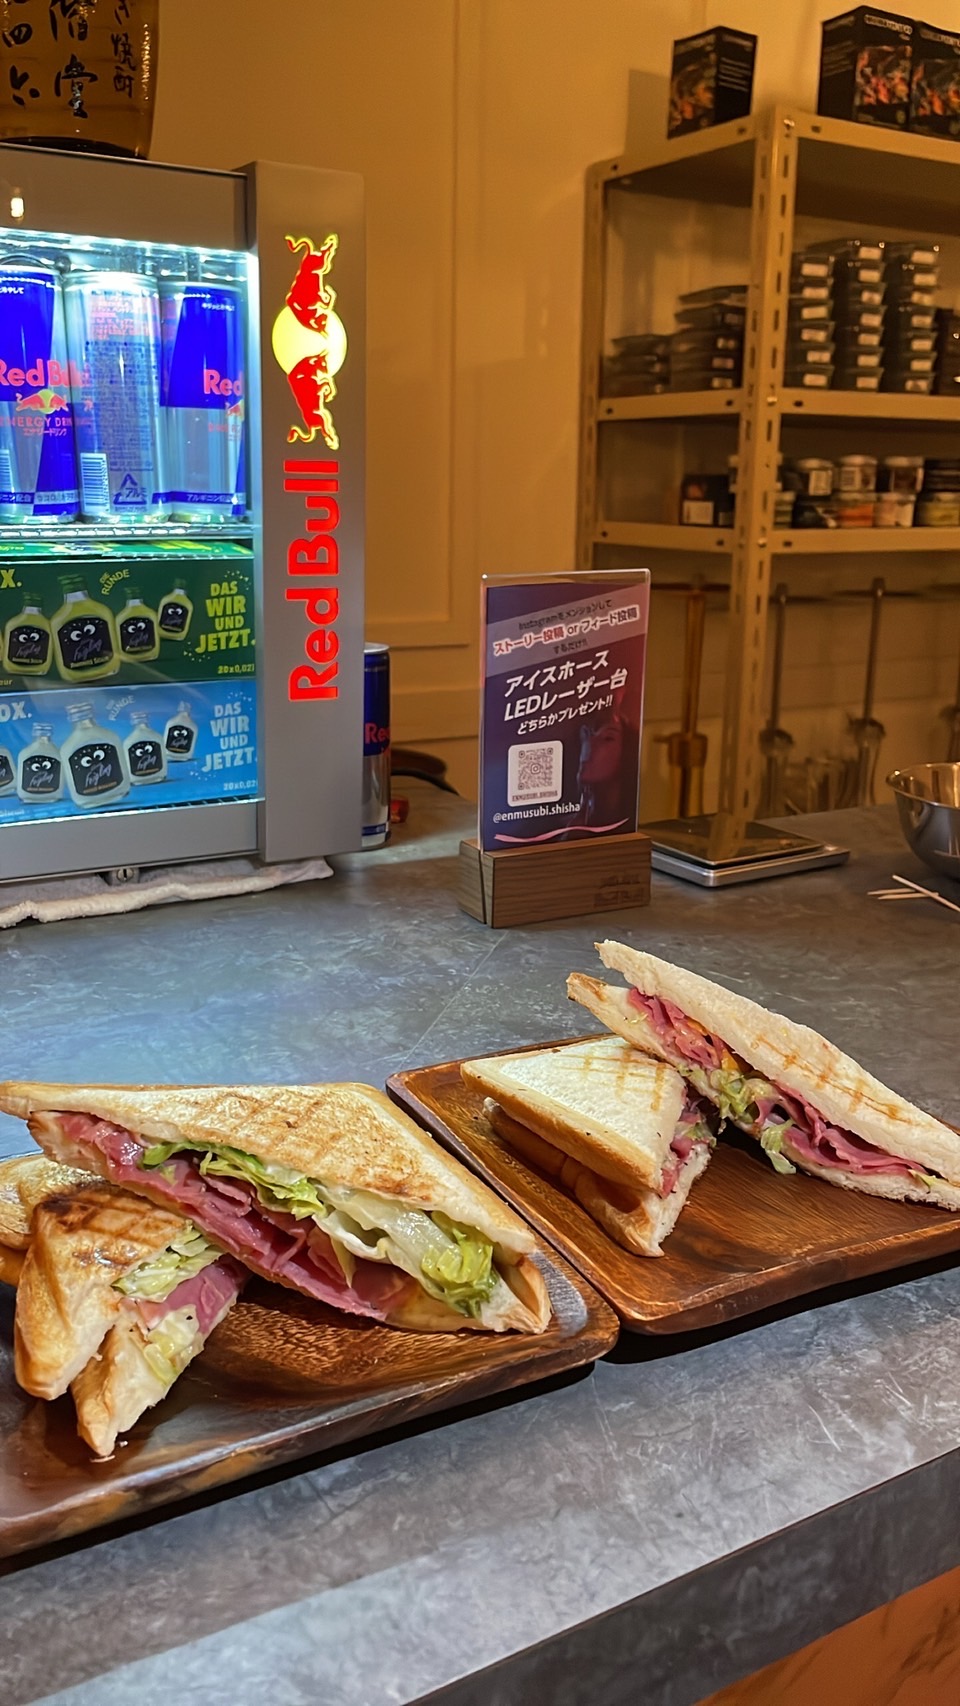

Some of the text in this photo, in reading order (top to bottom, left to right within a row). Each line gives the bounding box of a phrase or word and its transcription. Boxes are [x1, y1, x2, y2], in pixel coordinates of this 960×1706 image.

[203, 369, 243, 397] Red
[101, 569, 130, 595] RUNDE
[210, 581, 238, 597] DAS
[283, 459, 340, 702] Red Bull
[206, 595, 246, 617] WIR
[215, 615, 244, 631] UND
[567, 625, 579, 635] or
[195, 628, 256, 654] JETZT.
[504, 649, 610, 698] アイスホース
[503, 667, 628, 722] LEDレーザー台
[214, 701, 242, 718] DAS
[210, 715, 250, 737] WIR
[220, 734, 248, 750] UND
[493, 802, 581, 824] @enmusubi.shisha
